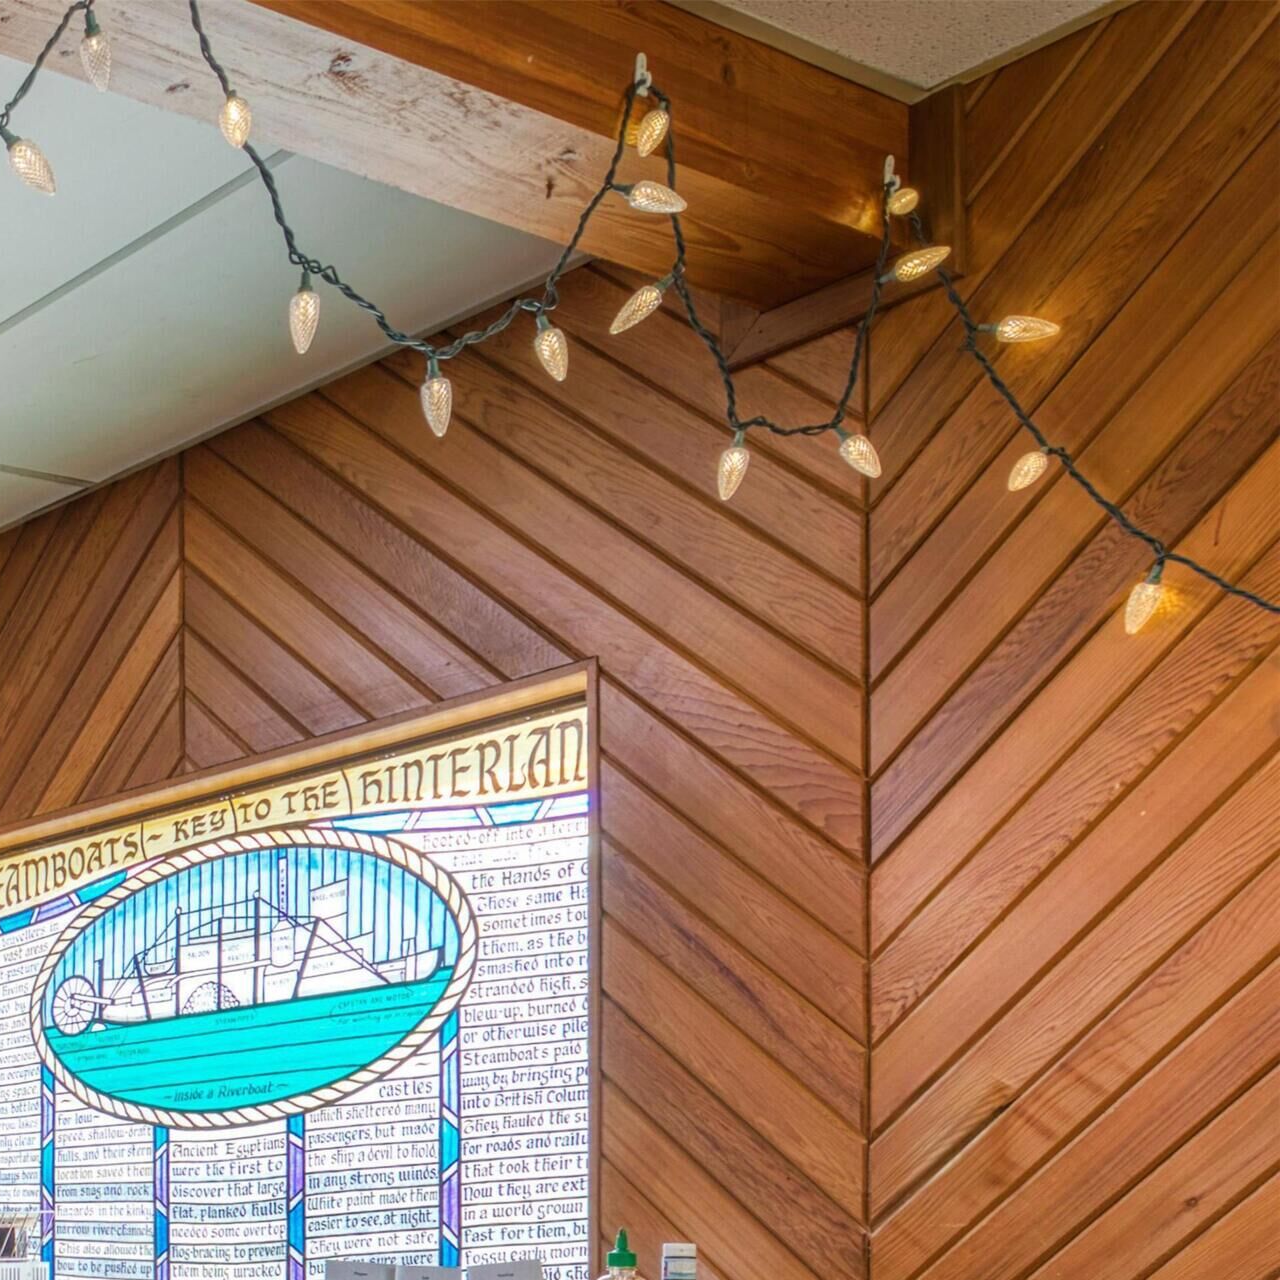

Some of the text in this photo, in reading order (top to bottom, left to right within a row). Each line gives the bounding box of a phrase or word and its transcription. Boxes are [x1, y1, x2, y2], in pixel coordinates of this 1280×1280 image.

[173, 809, 227, 843] KEY
[239, 798, 272, 825] TO
[282, 780, 341, 814] THE
[472, 862, 575, 890] the Hands of
[525, 889, 563, 906] same
[482, 911, 562, 933] sometimes
[527, 932, 574, 951] as the
[478, 953, 574, 977] smashed into
[469, 980, 535, 999] stranded
[527, 999, 576, 1017] burned
[463, 1021, 557, 1044] or otherwise
[463, 1041, 582, 1066] Steamboats paid
[462, 1065, 573, 1091] way by bringing
[217, 1080, 274, 1098] Riverboat
[378, 1080, 434, 1099] castles
[462, 1089, 543, 1111] into British
[309, 1102, 437, 1125] which sheltered many
[463, 1110, 571, 1135] They hauled the
[375, 1121, 437, 1139] but made
[172, 1137, 286, 1159] Ancient Egyptians
[463, 1134, 552, 1156] for roads and
[308, 1145, 410, 1168] the ship a devil to
[171, 1158, 284, 1177] were the first to
[464, 1155, 573, 1179] that took their
[171, 1181, 253, 1199] discover that
[308, 1170, 395, 1192] in any strong
[307, 1188, 438, 1212] White paint made them
[463, 1186, 493, 1201] Now
[498, 1183, 532, 1200] they
[535, 1182, 559, 1194] are
[200, 1200, 285, 1222] planked hulls
[463, 1201, 583, 1221] in a world grown
[171, 1225, 241, 1239] needed some
[308, 1218, 343, 1233] easier
[346, 1214, 359, 1229] to
[344, 1232, 400, 1250] were not
[464, 1226, 525, 1243] fast for
[233, 1243, 287, 1261] to prevent
[104, 1261, 138, 1276] pushed
[139, 1264, 153, 1278] up
[171, 1265, 200, 1278] them
[233, 1264, 282, 1278] wracked
